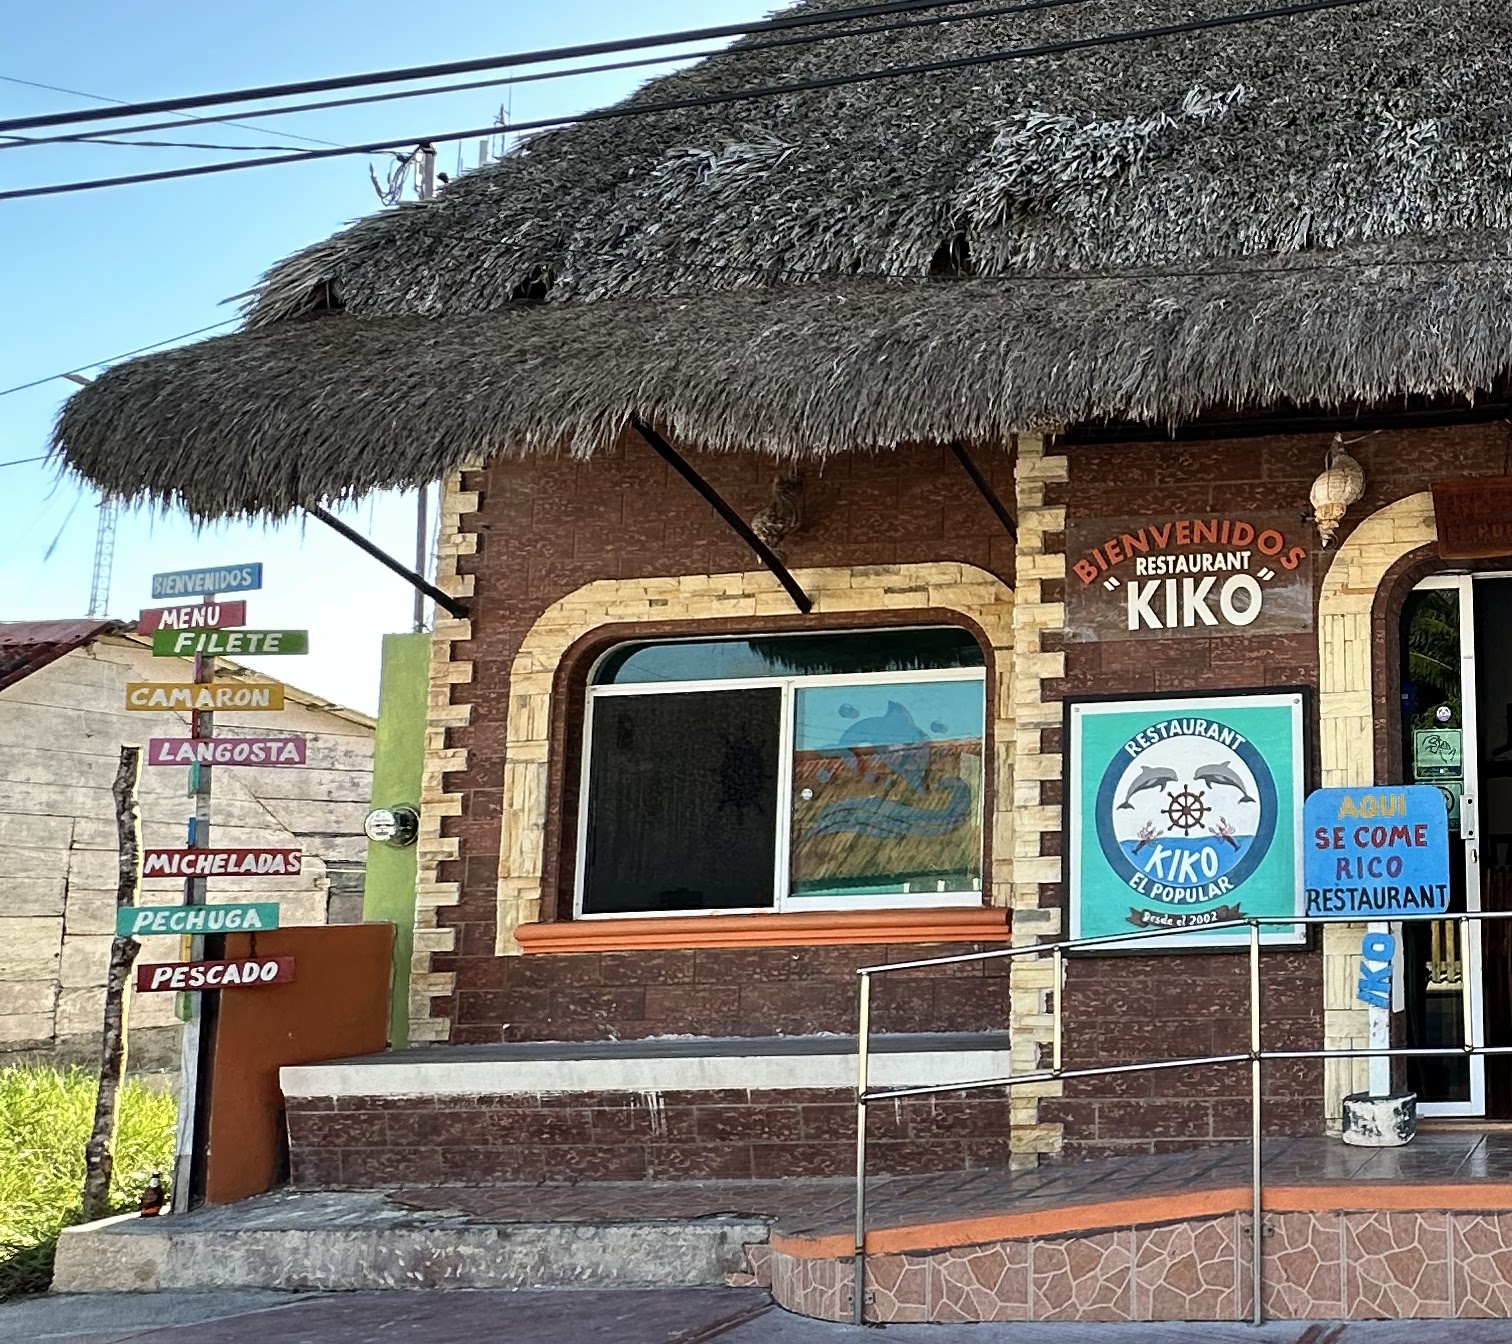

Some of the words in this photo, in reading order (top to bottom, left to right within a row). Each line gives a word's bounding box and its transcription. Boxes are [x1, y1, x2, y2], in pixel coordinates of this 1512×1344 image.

[1073, 519, 1307, 585] BIENVENIDOS
[1136, 551, 1251, 577] RESTAURANT
[154, 568, 253, 596] BIENVENIDOS
[158, 605, 220, 631] MENU
[173, 632, 281, 654] FILETE
[130, 687, 271, 709] CAMARON
[158, 741, 301, 763] LANGOSTA
[1124, 719, 1248, 758] RESTAURANT
[1338, 794, 1407, 821] AQUI
[1315, 826, 1345, 850] SE
[1354, 823, 1428, 849] COME
[144, 852, 301, 876] MICHELADAS
[1144, 844, 1219, 884] KIKO
[1336, 854, 1404, 881] RICO
[1129, 872, 1148, 898] EL
[1150, 875, 1235, 905] POPULAR
[1306, 883, 1448, 914] RESTAURANT
[132, 910, 262, 933] PECHUGA
[1142, 910, 1174, 926] Desde
[1176, 917, 1186, 927] el
[1189, 911, 1218, 926] 2002
[151, 962, 279, 989] PESCADO
